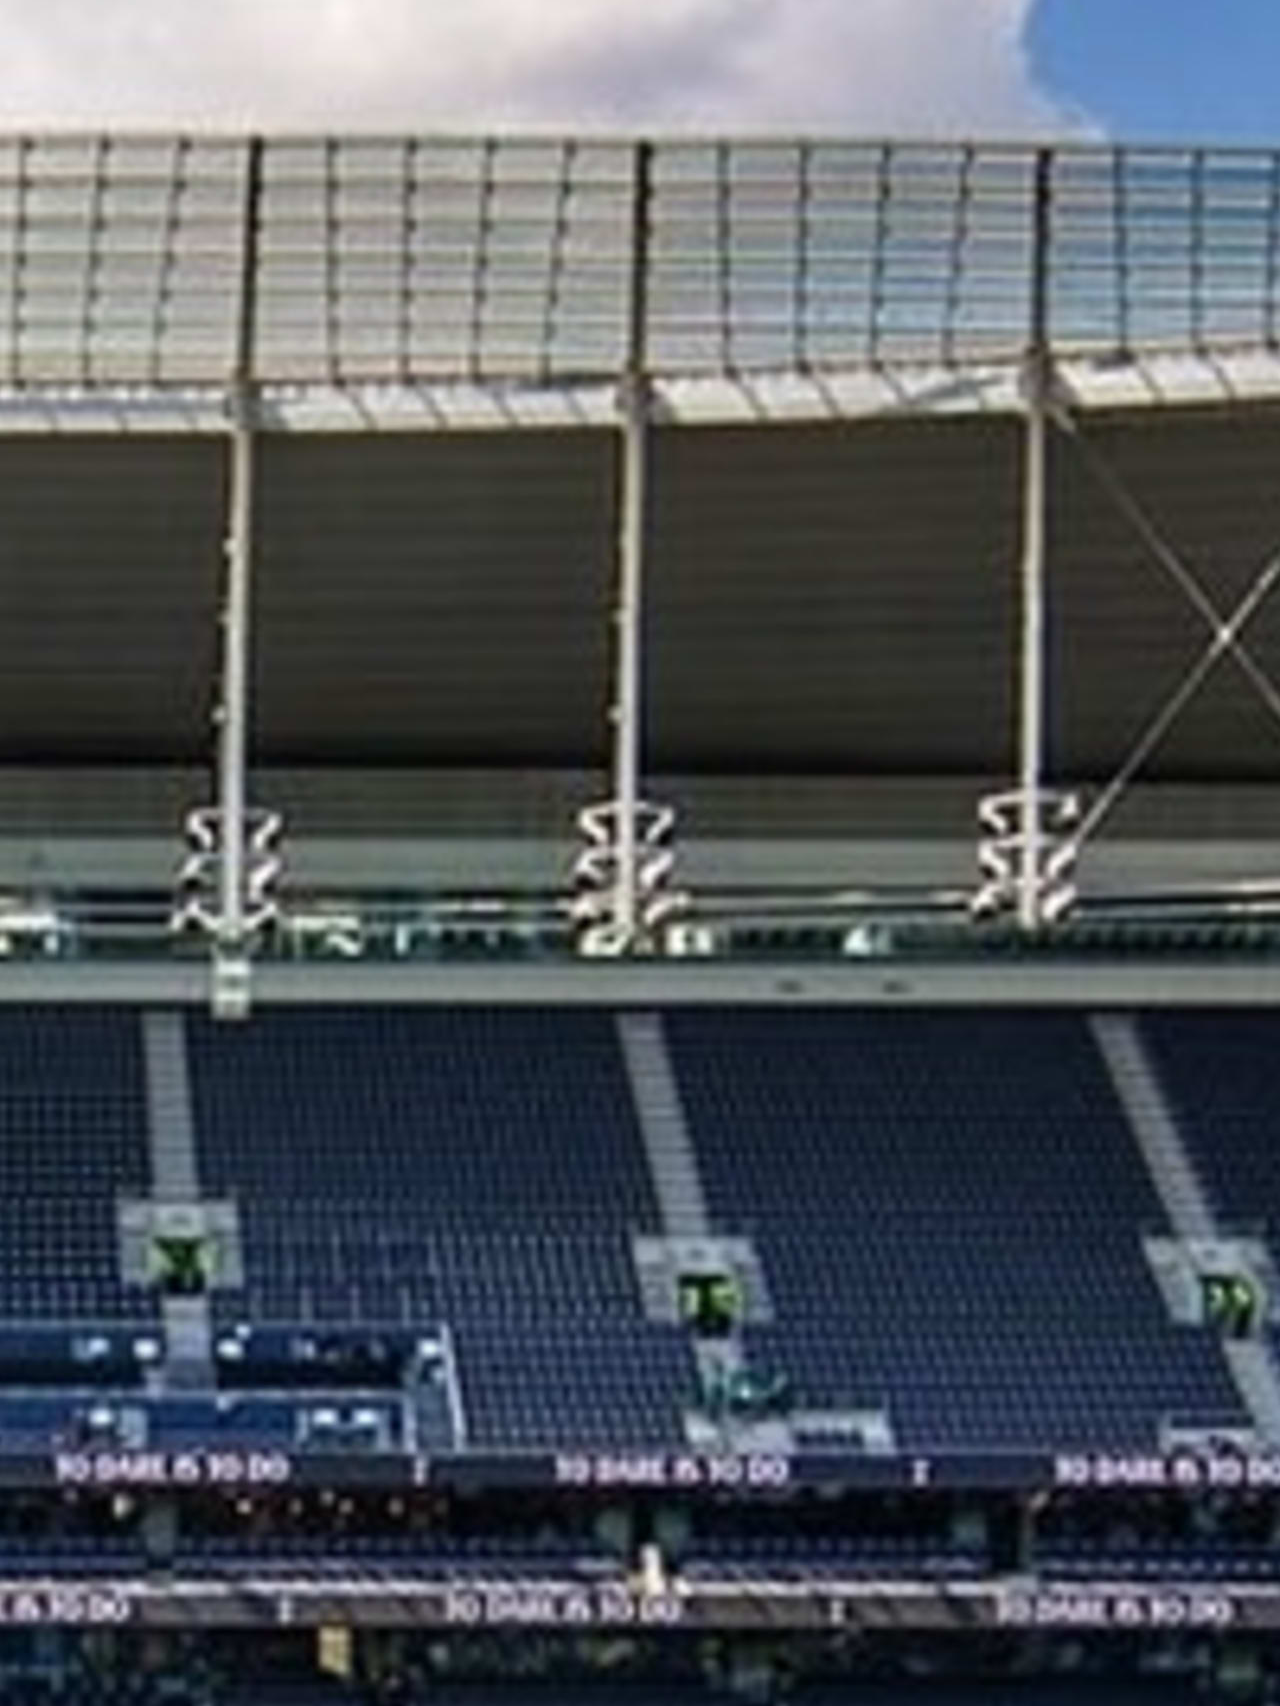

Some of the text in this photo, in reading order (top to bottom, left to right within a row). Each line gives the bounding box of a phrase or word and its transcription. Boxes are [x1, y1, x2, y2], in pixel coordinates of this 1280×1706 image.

[56, 1453, 91, 1483] TO
[208, 1453, 244, 1483] TO
[247, 1453, 291, 1483] DO
[555, 1456, 591, 1485] TO
[708, 1456, 744, 1485] TO
[747, 1456, 790, 1485] DO
[1055, 1456, 1091, 1485] TO
[1207, 1456, 1243, 1485] TO
[48, 1593, 83, 1623] TO
[87, 1593, 131, 1623] DO
[446, 1595, 481, 1624] TO
[599, 1595, 634, 1624] TO
[638, 1595, 681, 1624] DO
[997, 1596, 1032, 1626] TO
[1150, 1596, 1185, 1626] TO
[1189, 1596, 1234, 1626] DO
